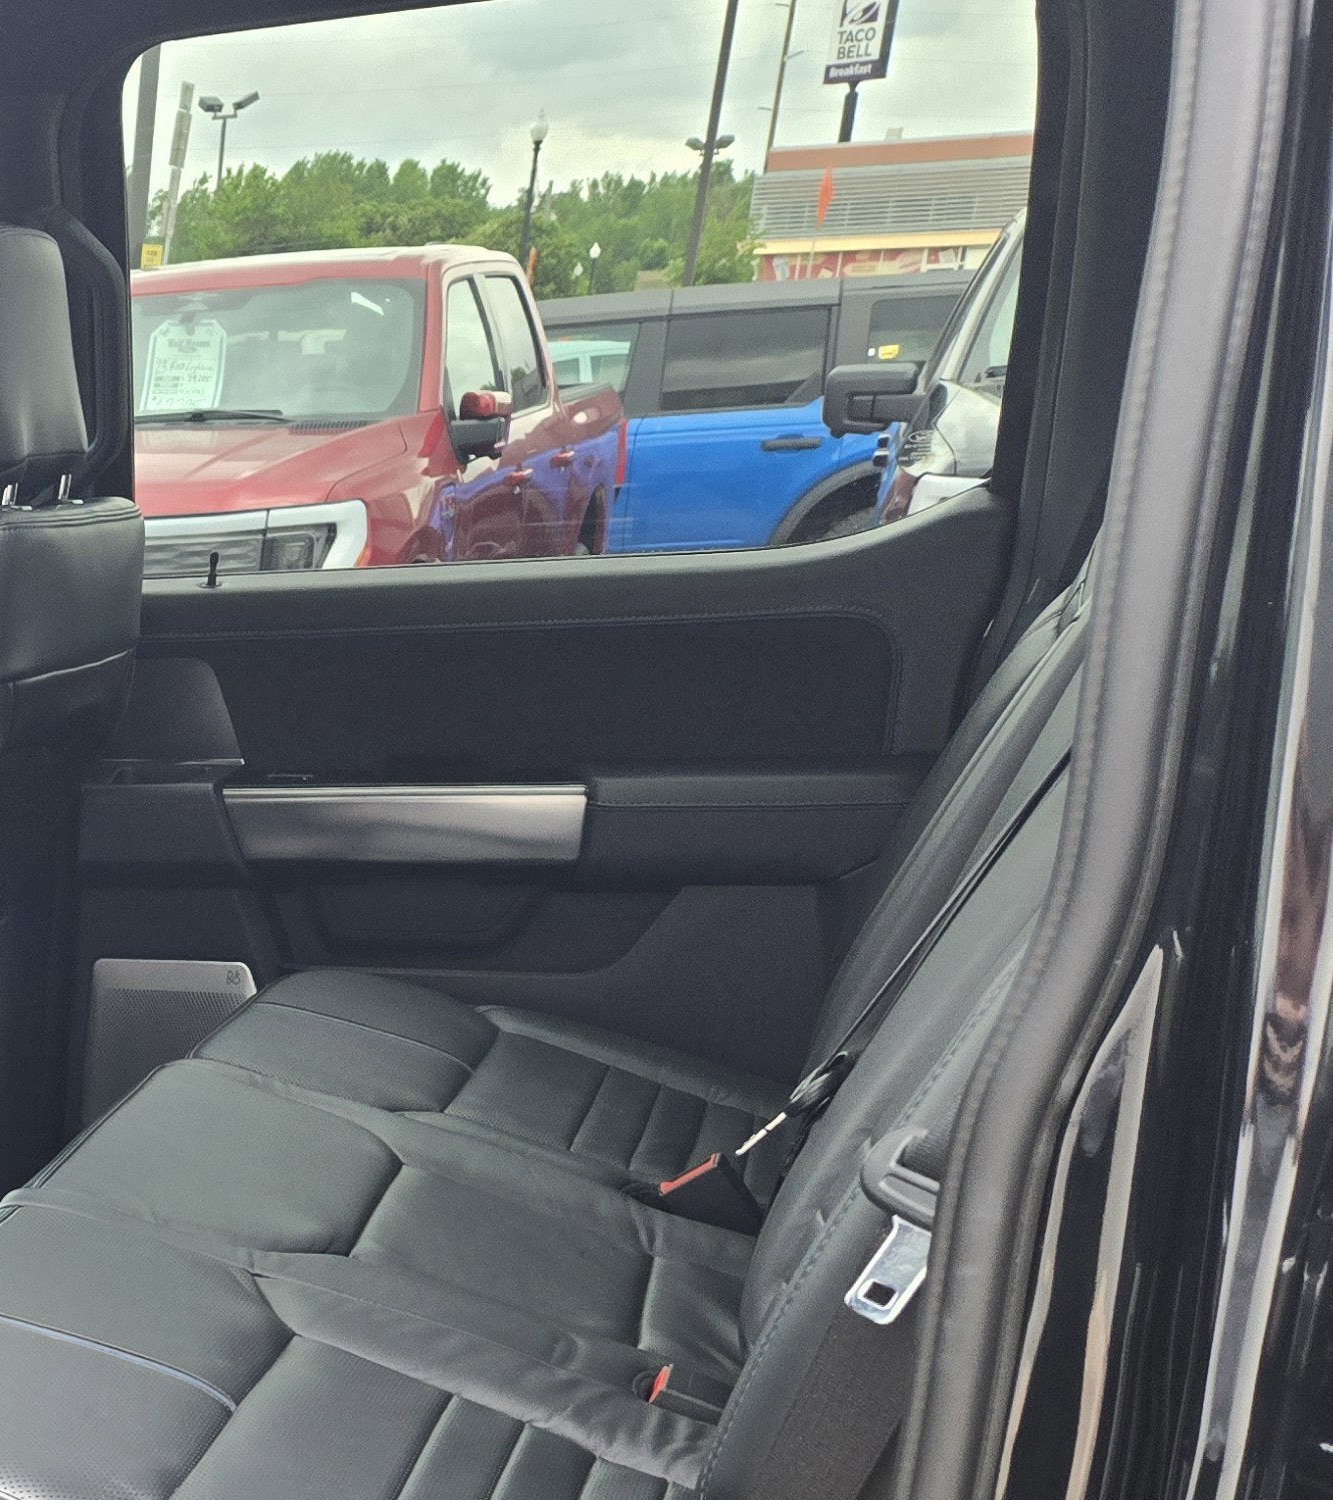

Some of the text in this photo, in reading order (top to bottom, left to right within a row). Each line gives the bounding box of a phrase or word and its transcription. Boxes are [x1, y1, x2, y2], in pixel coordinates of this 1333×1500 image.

[837, 27, 876, 45] TACO
[836, 43, 872, 60] BELL
[829, 63, 872, 78] Breakfast
